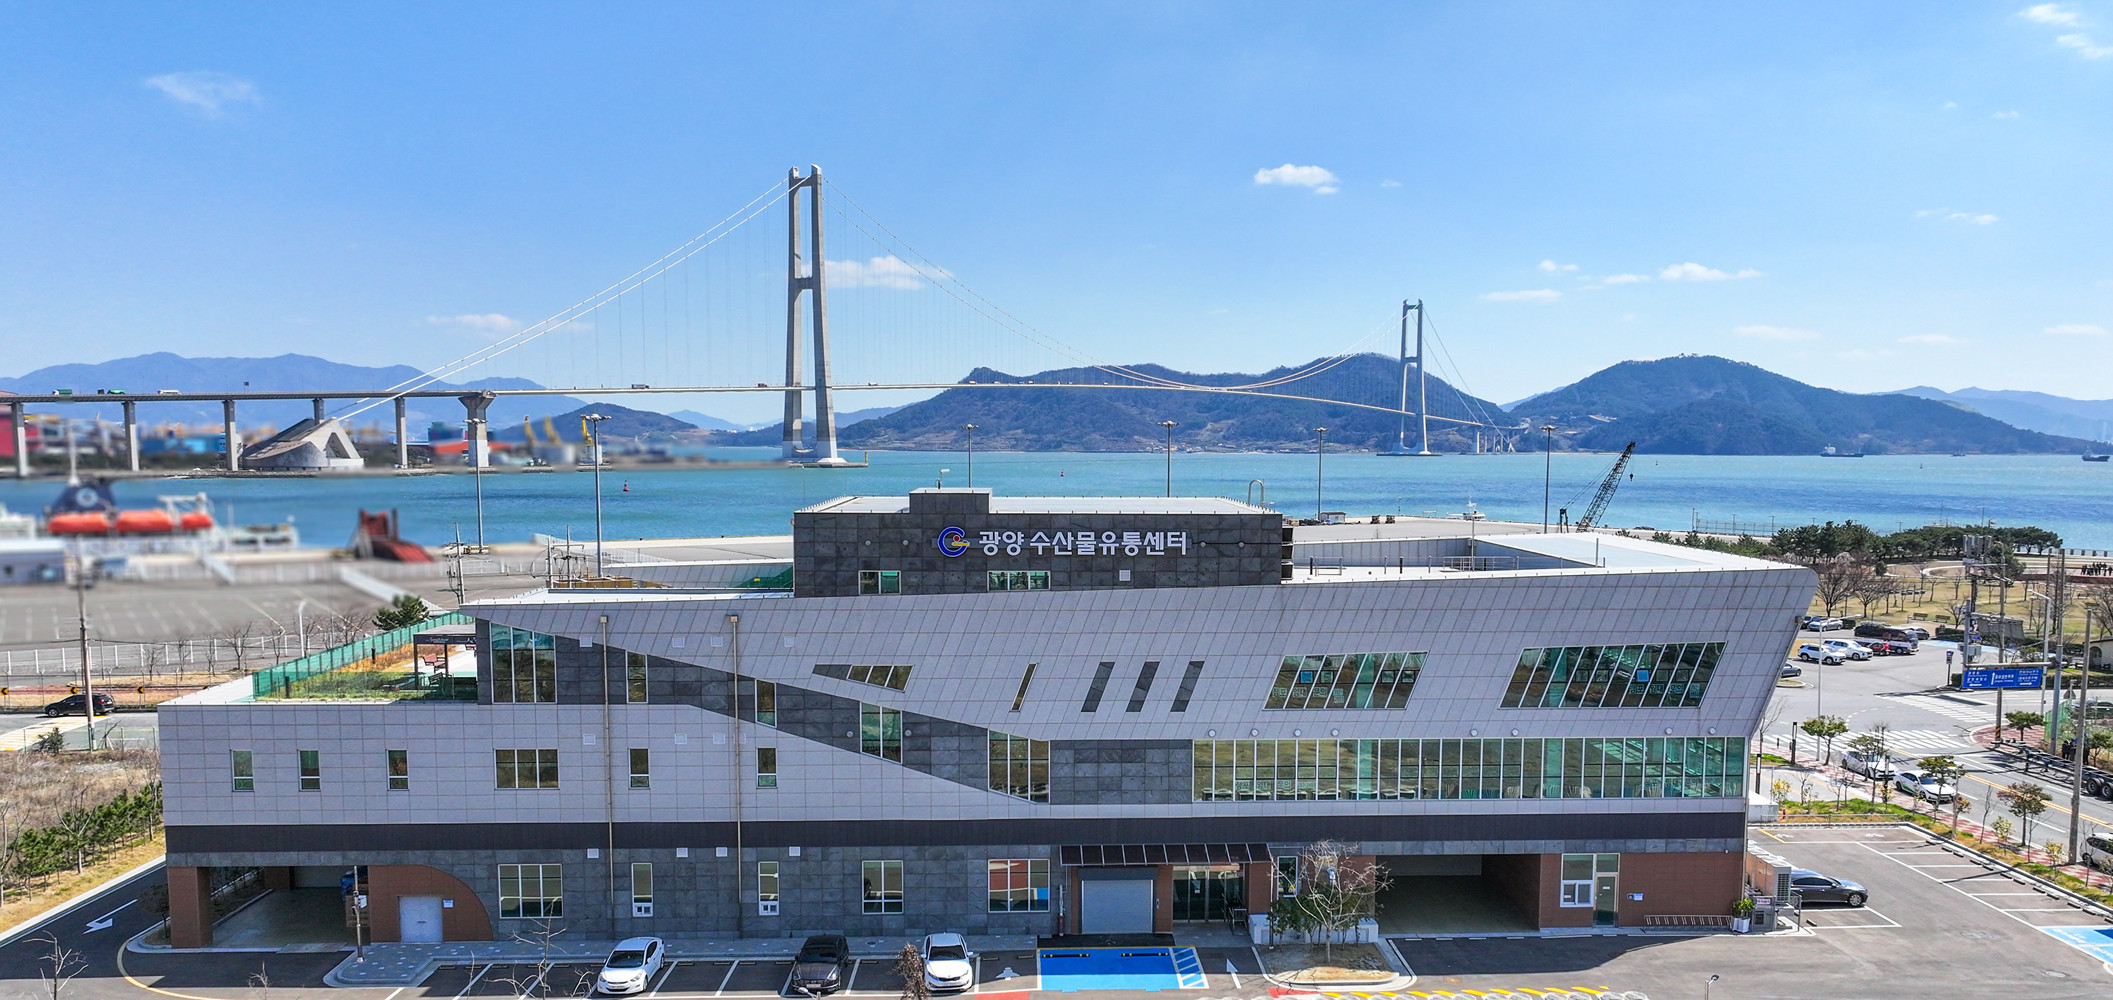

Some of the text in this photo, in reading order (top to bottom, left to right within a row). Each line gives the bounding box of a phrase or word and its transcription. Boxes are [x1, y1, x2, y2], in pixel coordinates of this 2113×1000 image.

[979, 531, 1187, 556] 광양 수산물유통센터
[1293, 687, 1307, 697] 임대
[1313, 687, 1327, 697] 문의
